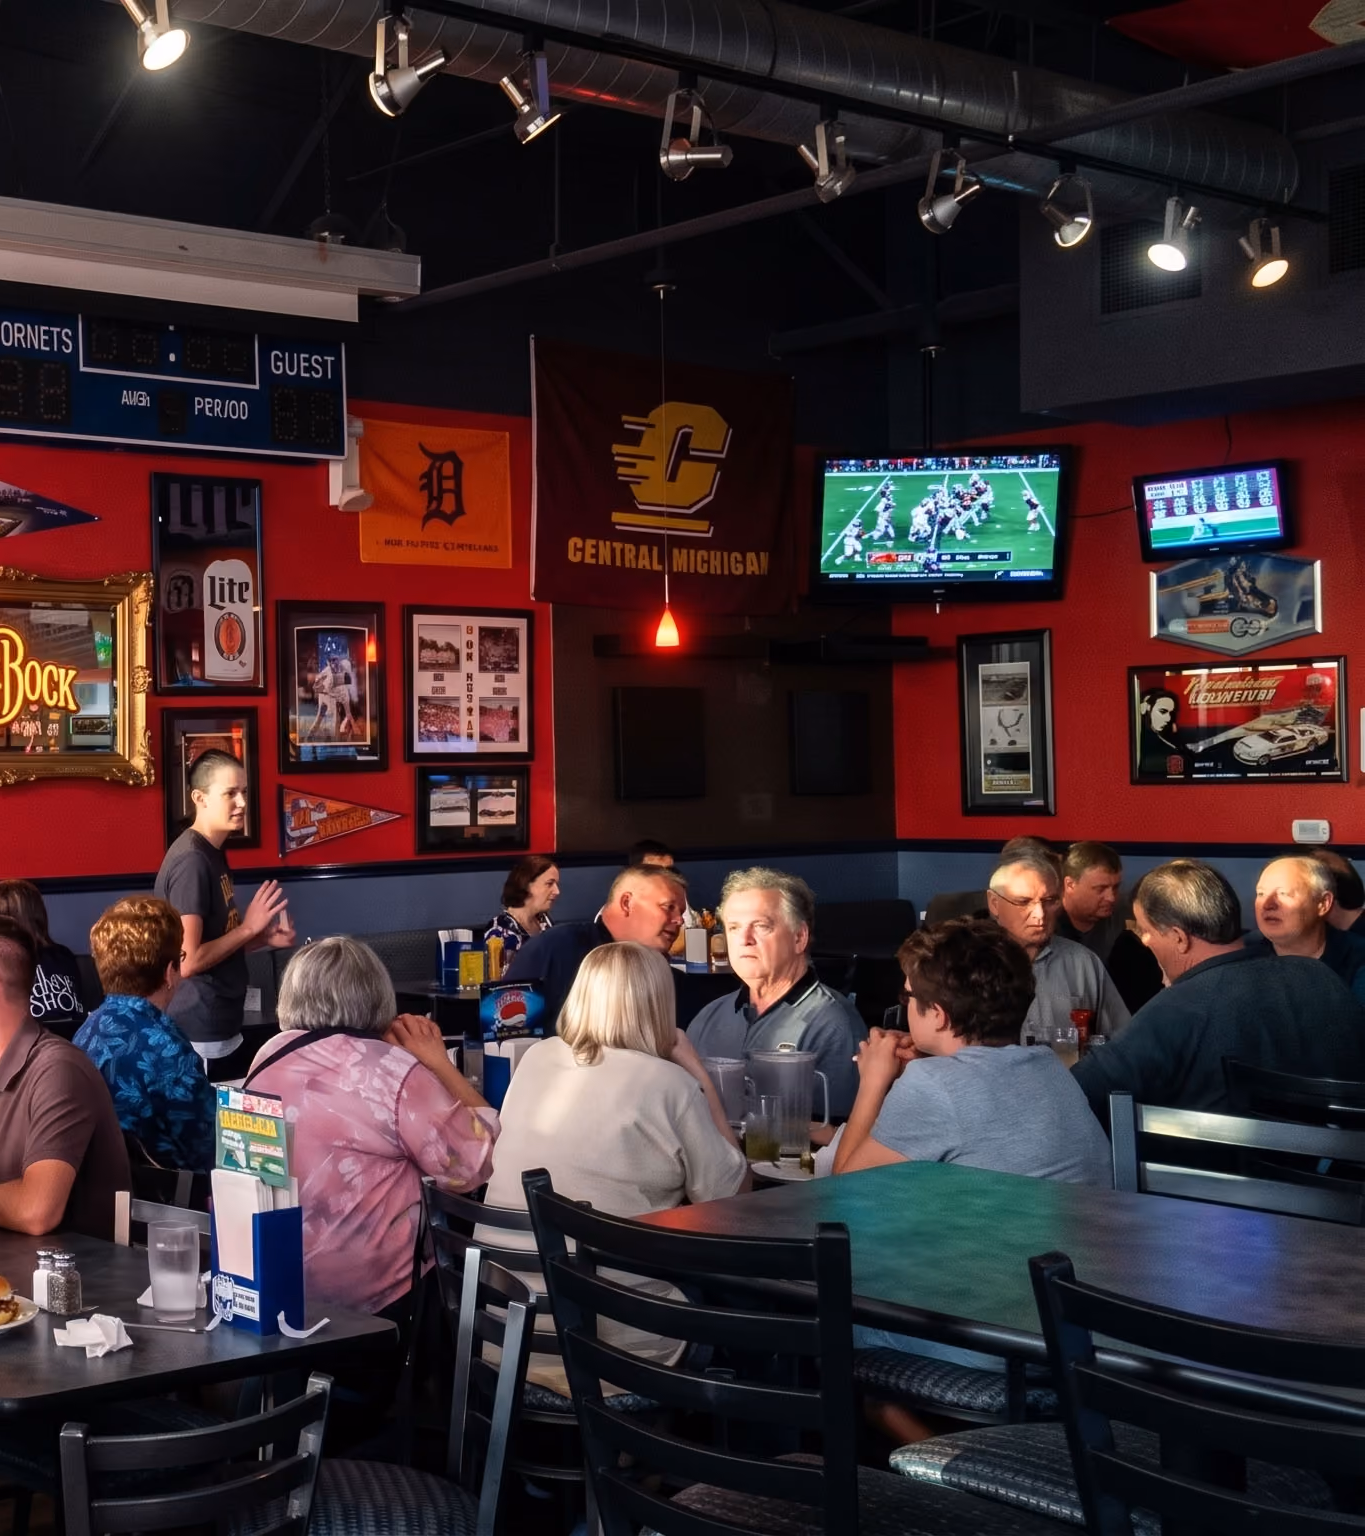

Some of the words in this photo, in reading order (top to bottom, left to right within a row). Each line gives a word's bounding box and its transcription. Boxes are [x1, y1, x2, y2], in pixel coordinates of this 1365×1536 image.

[271, 351, 335, 379] GUEST
[418, 441, 467, 532] D
[567, 536, 663, 571] CENTRAL
[672, 547, 769, 576] MICHIGAN
[207, 575, 250, 611] Lite
